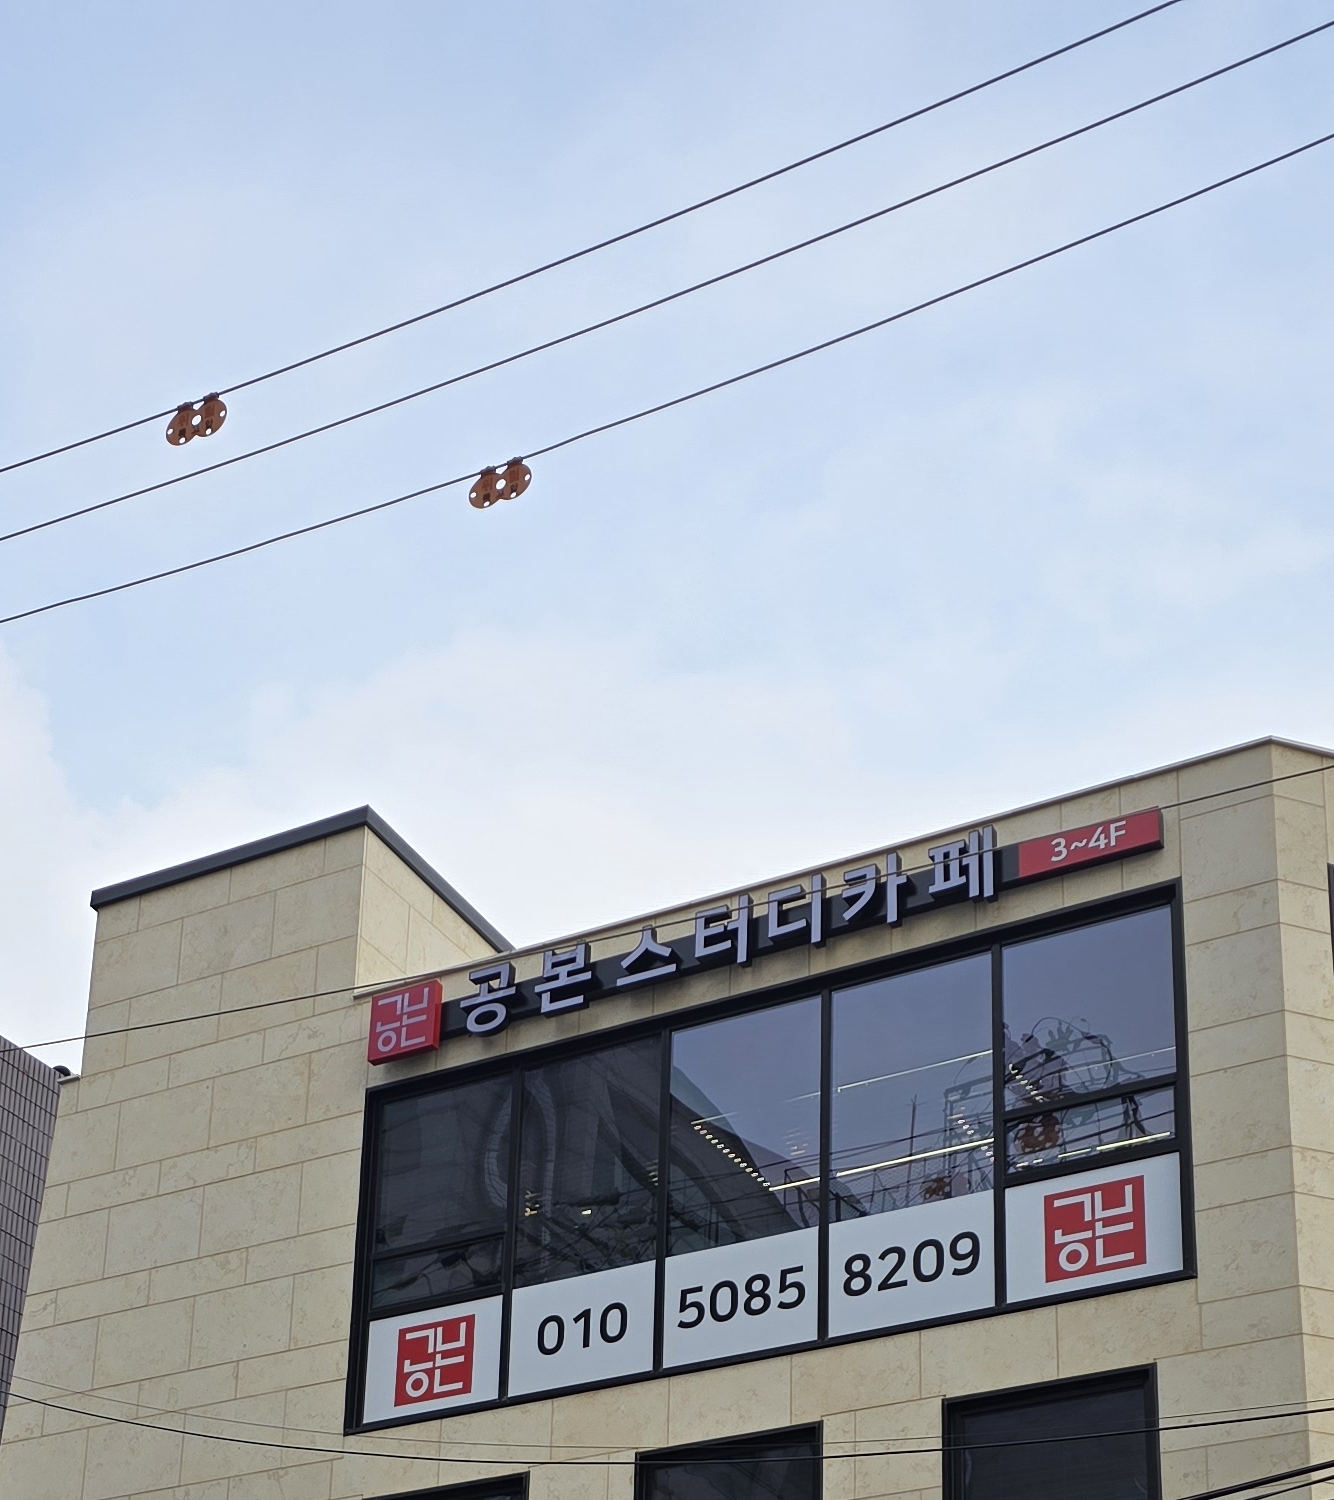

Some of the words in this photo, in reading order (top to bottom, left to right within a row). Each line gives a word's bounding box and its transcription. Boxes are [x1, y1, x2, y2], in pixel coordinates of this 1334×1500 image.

[459, 826, 996, 1036] 공본스터디카페
[1050, 821, 1126, 862] 3~4F
[537, 1302, 628, 1356] 010
[677, 1265, 807, 1330] 5085
[843, 1231, 981, 1297] 8209
